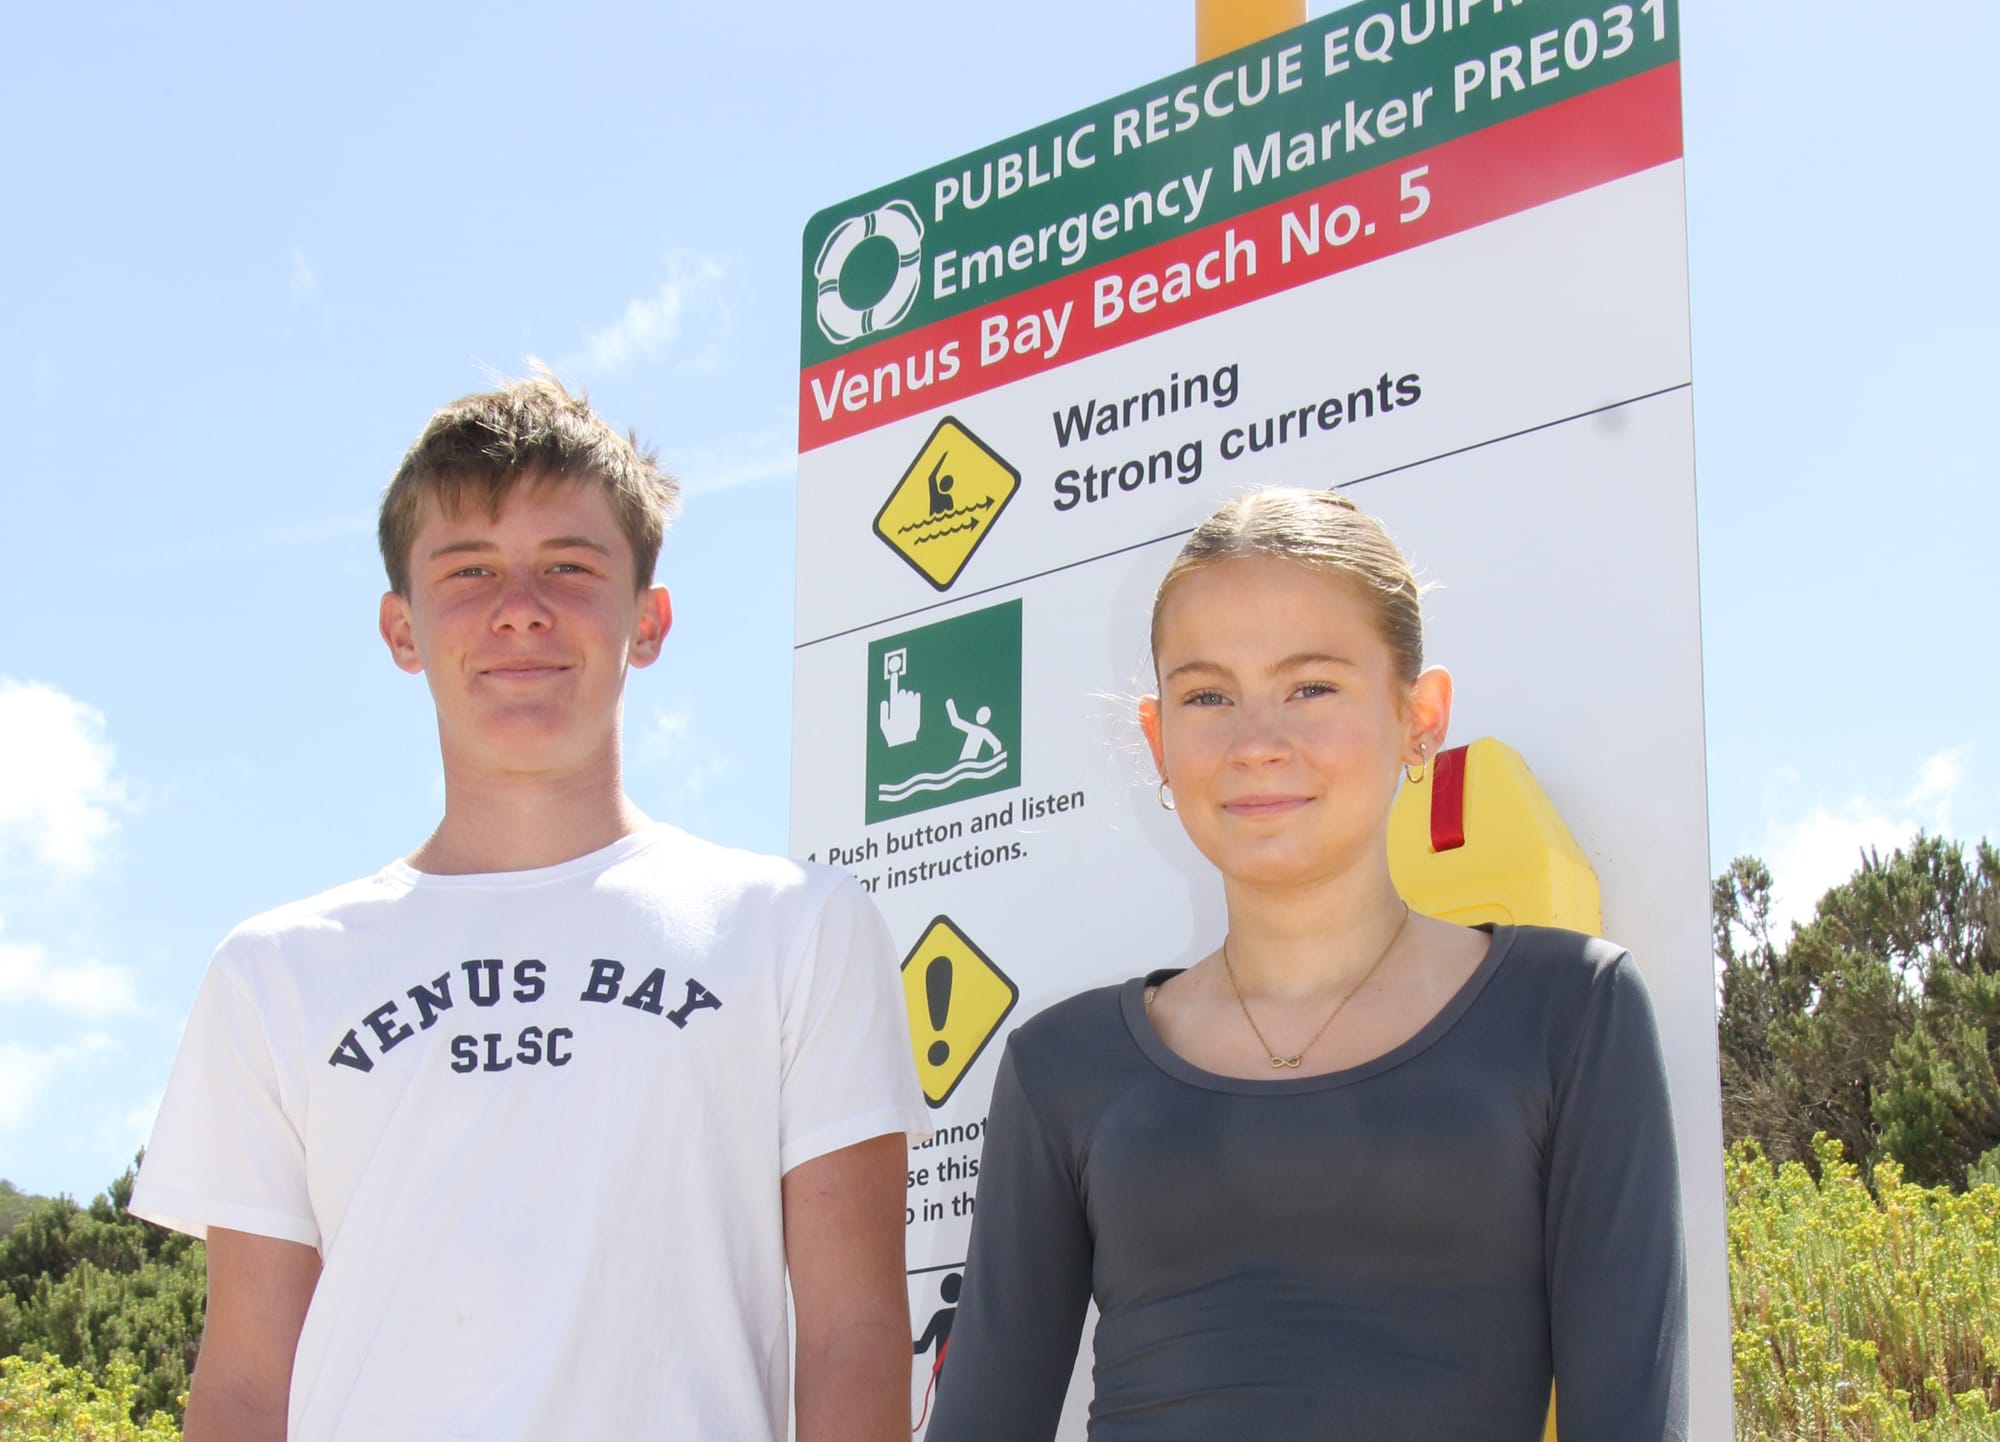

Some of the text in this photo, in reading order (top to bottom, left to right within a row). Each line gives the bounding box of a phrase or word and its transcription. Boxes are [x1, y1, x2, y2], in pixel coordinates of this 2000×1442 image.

[934, 0, 1666, 300] Emergency Marker PRE031
[935, 0, 1523, 222] PUBLIC RESCUE EQUIP
[810, 166, 1432, 423] Venus Bay Beach No. 5
[1052, 363, 1240, 449] Warning
[1053, 371, 1423, 512] Strong currents
[829, 837, 879, 866] Push
[886, 820, 963, 856] button
[970, 802, 1014, 834] and
[1021, 790, 1085, 822] listen
[853, 841, 1028, 894] or instructions.
[328, 958, 723, 1074] VENUS BAY
[451, 1025, 574, 1074] SLSC
[923, 1198, 944, 1222] in
[936, 1155, 979, 1183] this
